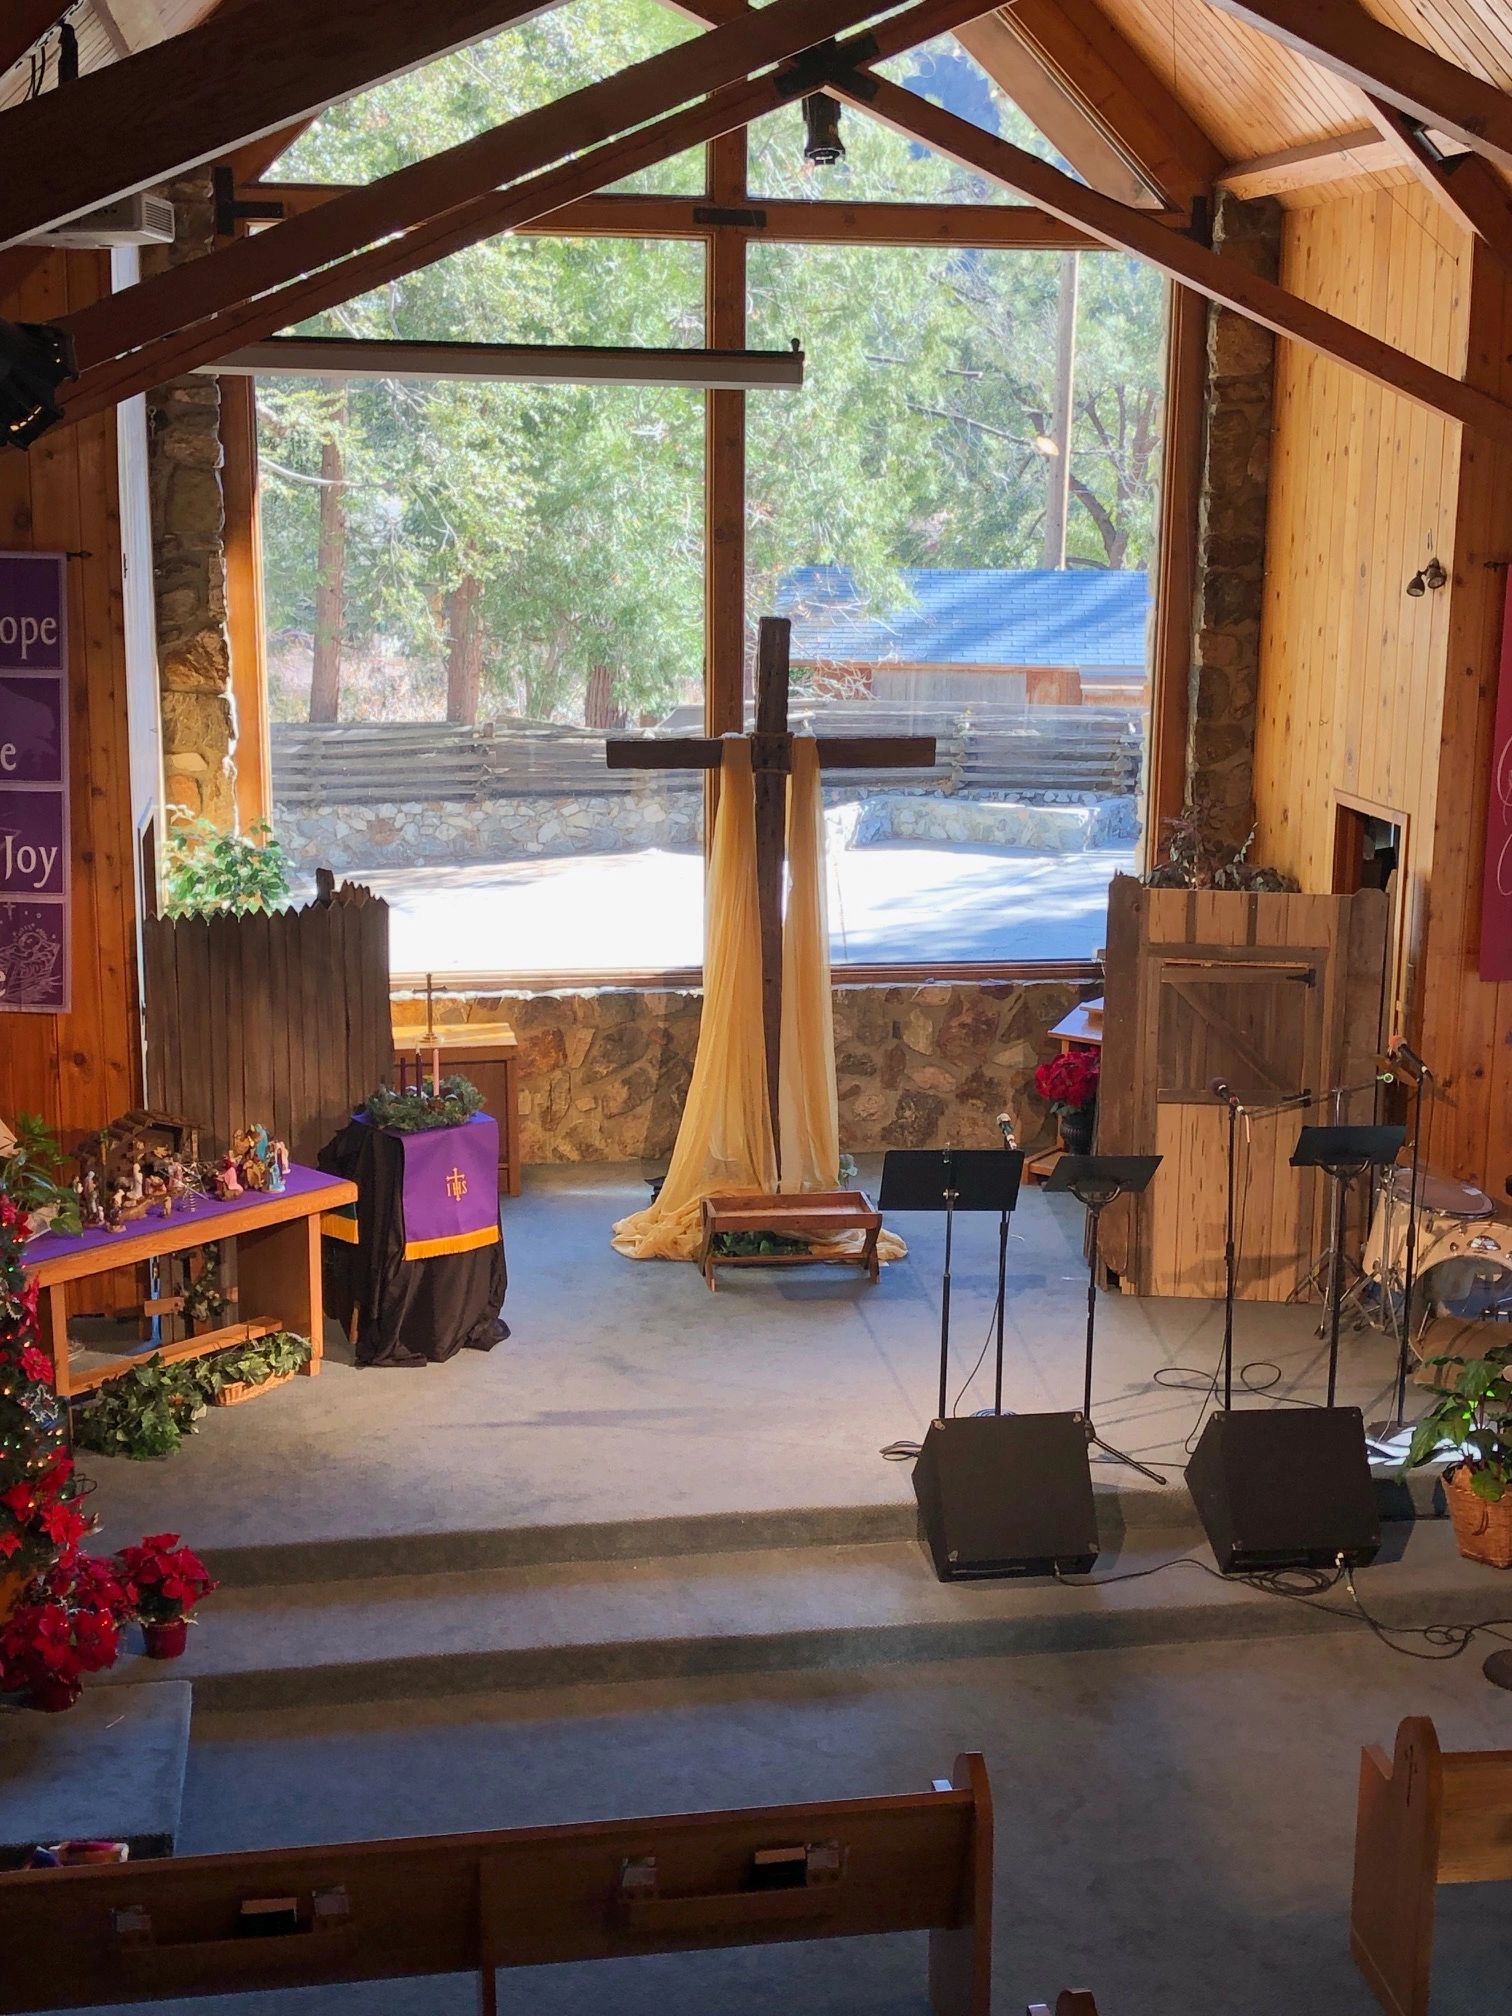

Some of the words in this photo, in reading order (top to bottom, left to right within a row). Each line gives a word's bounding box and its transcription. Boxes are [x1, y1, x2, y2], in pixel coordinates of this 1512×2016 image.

[0, 616, 57, 660] ope
[4, 835, 58, 888] Joy
[446, 1181, 468, 1197] IHS
